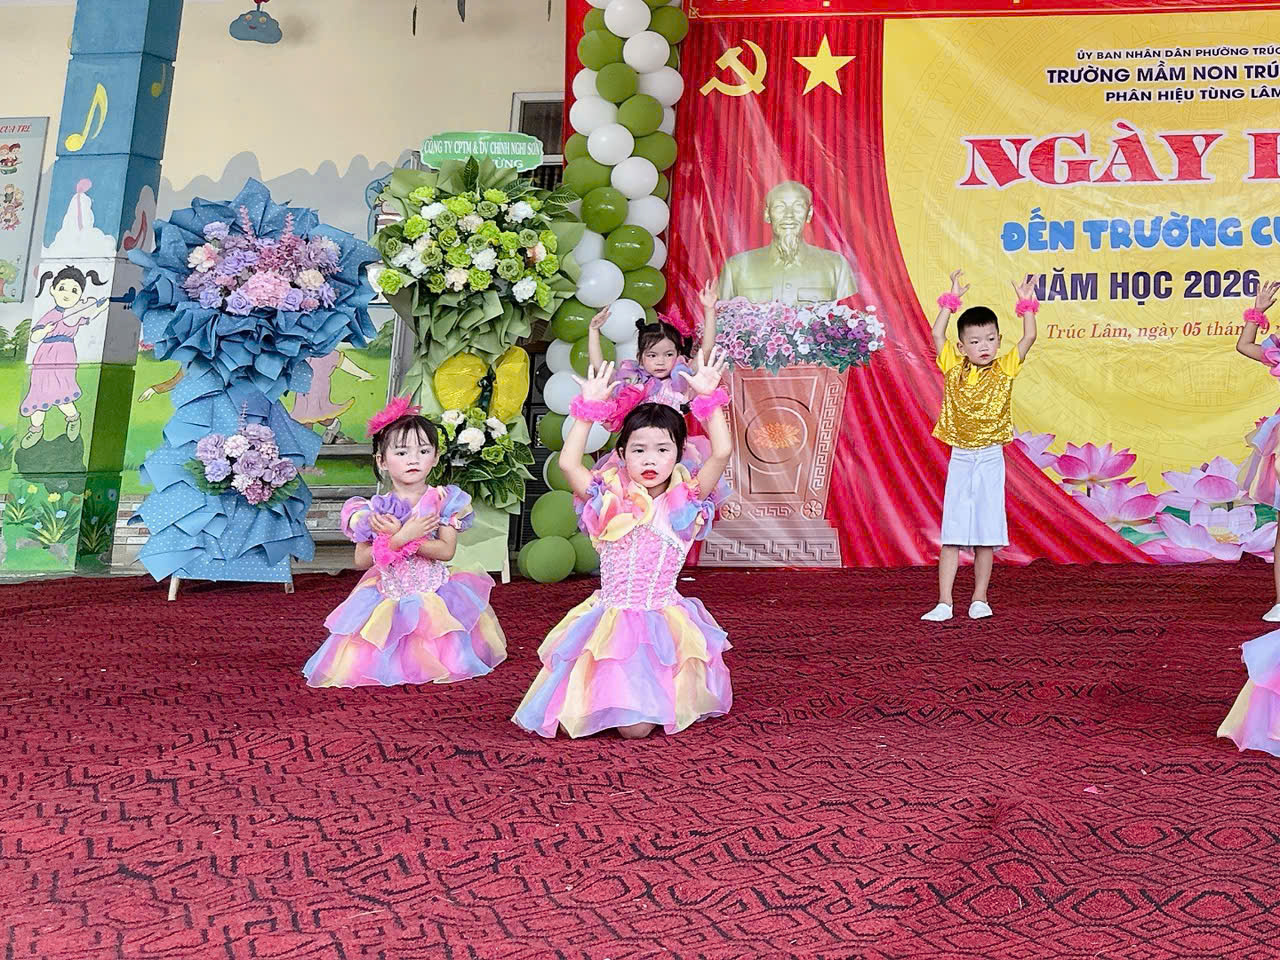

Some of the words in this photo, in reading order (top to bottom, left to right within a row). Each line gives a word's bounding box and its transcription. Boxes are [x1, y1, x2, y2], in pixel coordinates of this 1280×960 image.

[1077, 50, 1093, 60] ỦY
[1096, 51, 1121, 60] BAN
[1126, 49, 1161, 59] NHÂN
[1165, 48, 1191, 58] DÂN
[1196, 46, 1249, 56] PHƯỜNG
[1047, 65, 1131, 83] TRƯỜNG
[1137, 60, 1186, 82] MẦM
[1193, 65, 1237, 80] NON
[1105, 88, 1152, 101] PHÂN
[1158, 87, 1194, 103] HIỆU
[1200, 87, 1245, 100] TÙNG
[472, 141, 479, 154] &
[959, 120, 1224, 187] NGÀY
[493, 157, 523, 169] ỪNG
[1000, 207, 1075, 251] ĐẾN
[1083, 210, 1242, 250] TRƯỜNG
[1110, 271, 1173, 305] HỌC
[1184, 270, 1260, 298] 2026
[1047, 323, 1086, 339] Trúc
[1090, 323, 1132, 340] Lâm,
[1138, 323, 1179, 340] ngày
[1183, 322, 1202, 336] 05
